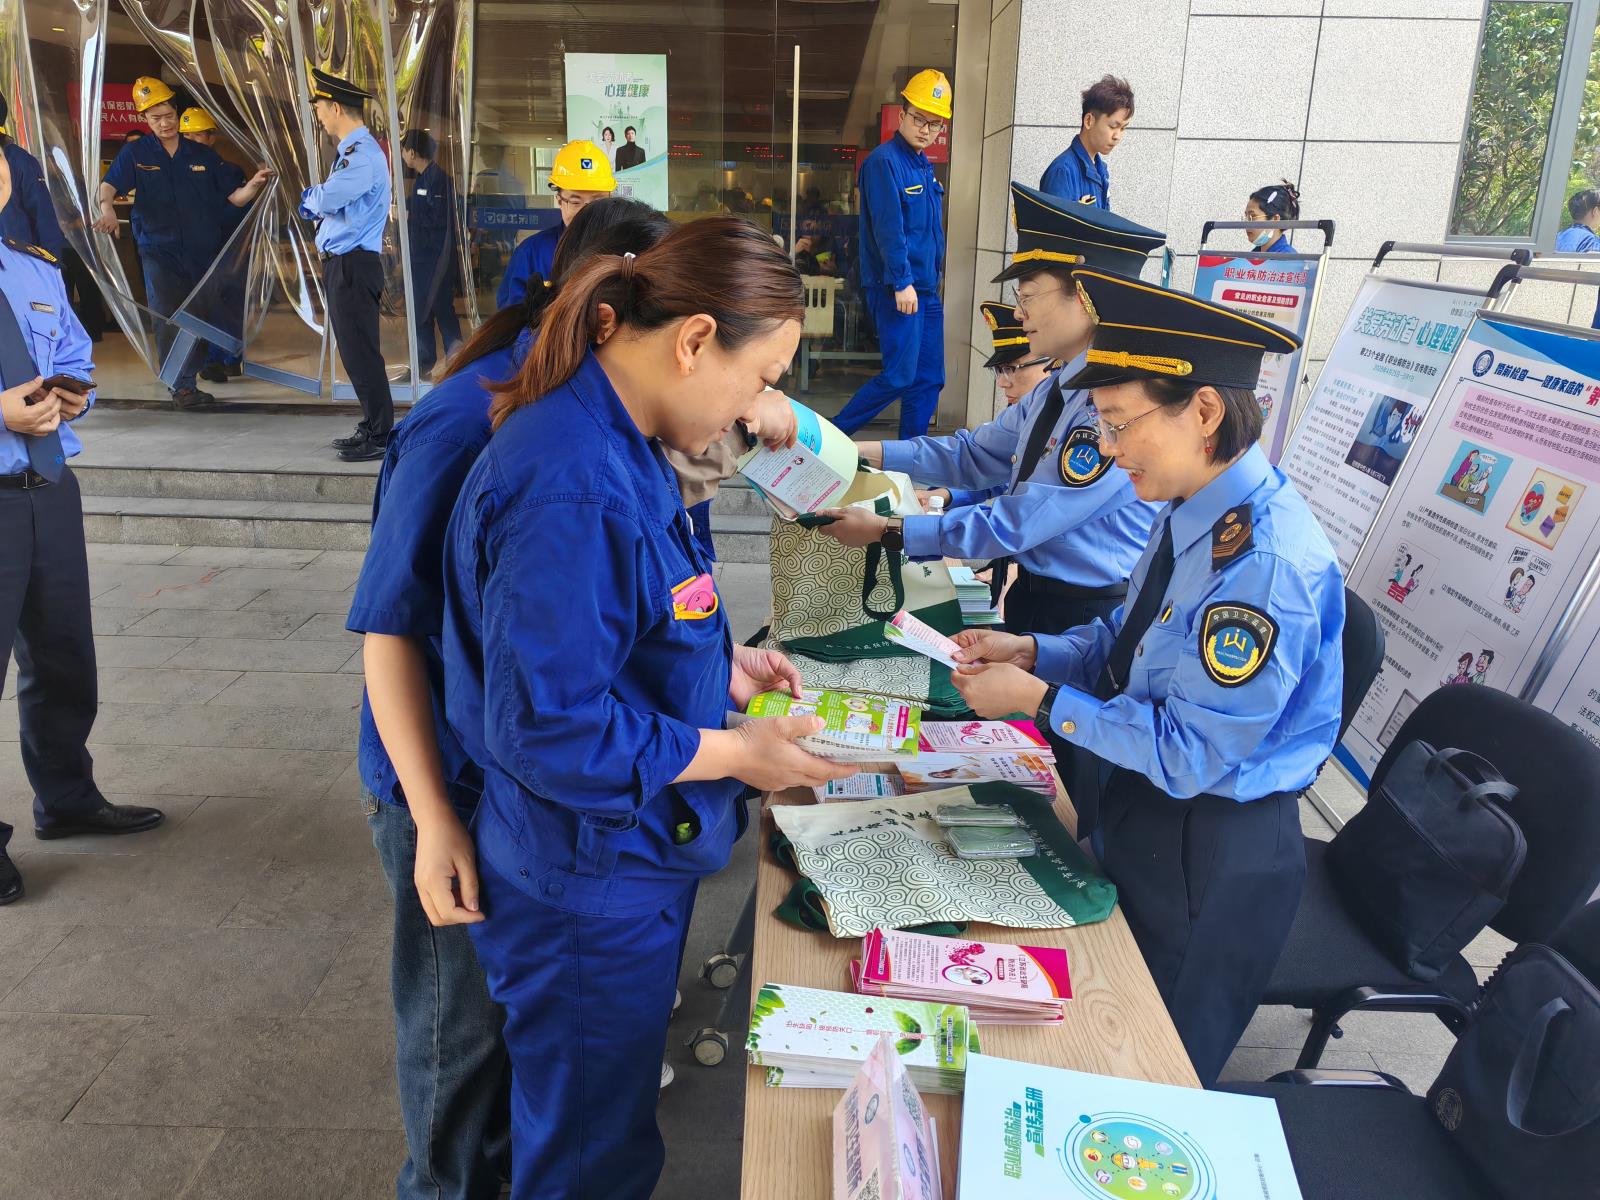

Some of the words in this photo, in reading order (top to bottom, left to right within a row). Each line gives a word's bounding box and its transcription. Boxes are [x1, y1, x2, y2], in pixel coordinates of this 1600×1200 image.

[604, 83, 650, 98] 心理健康
[1004, 1107, 1022, 1179] 职业病防治
[1025, 1086, 1044, 1145] 宣传手册
